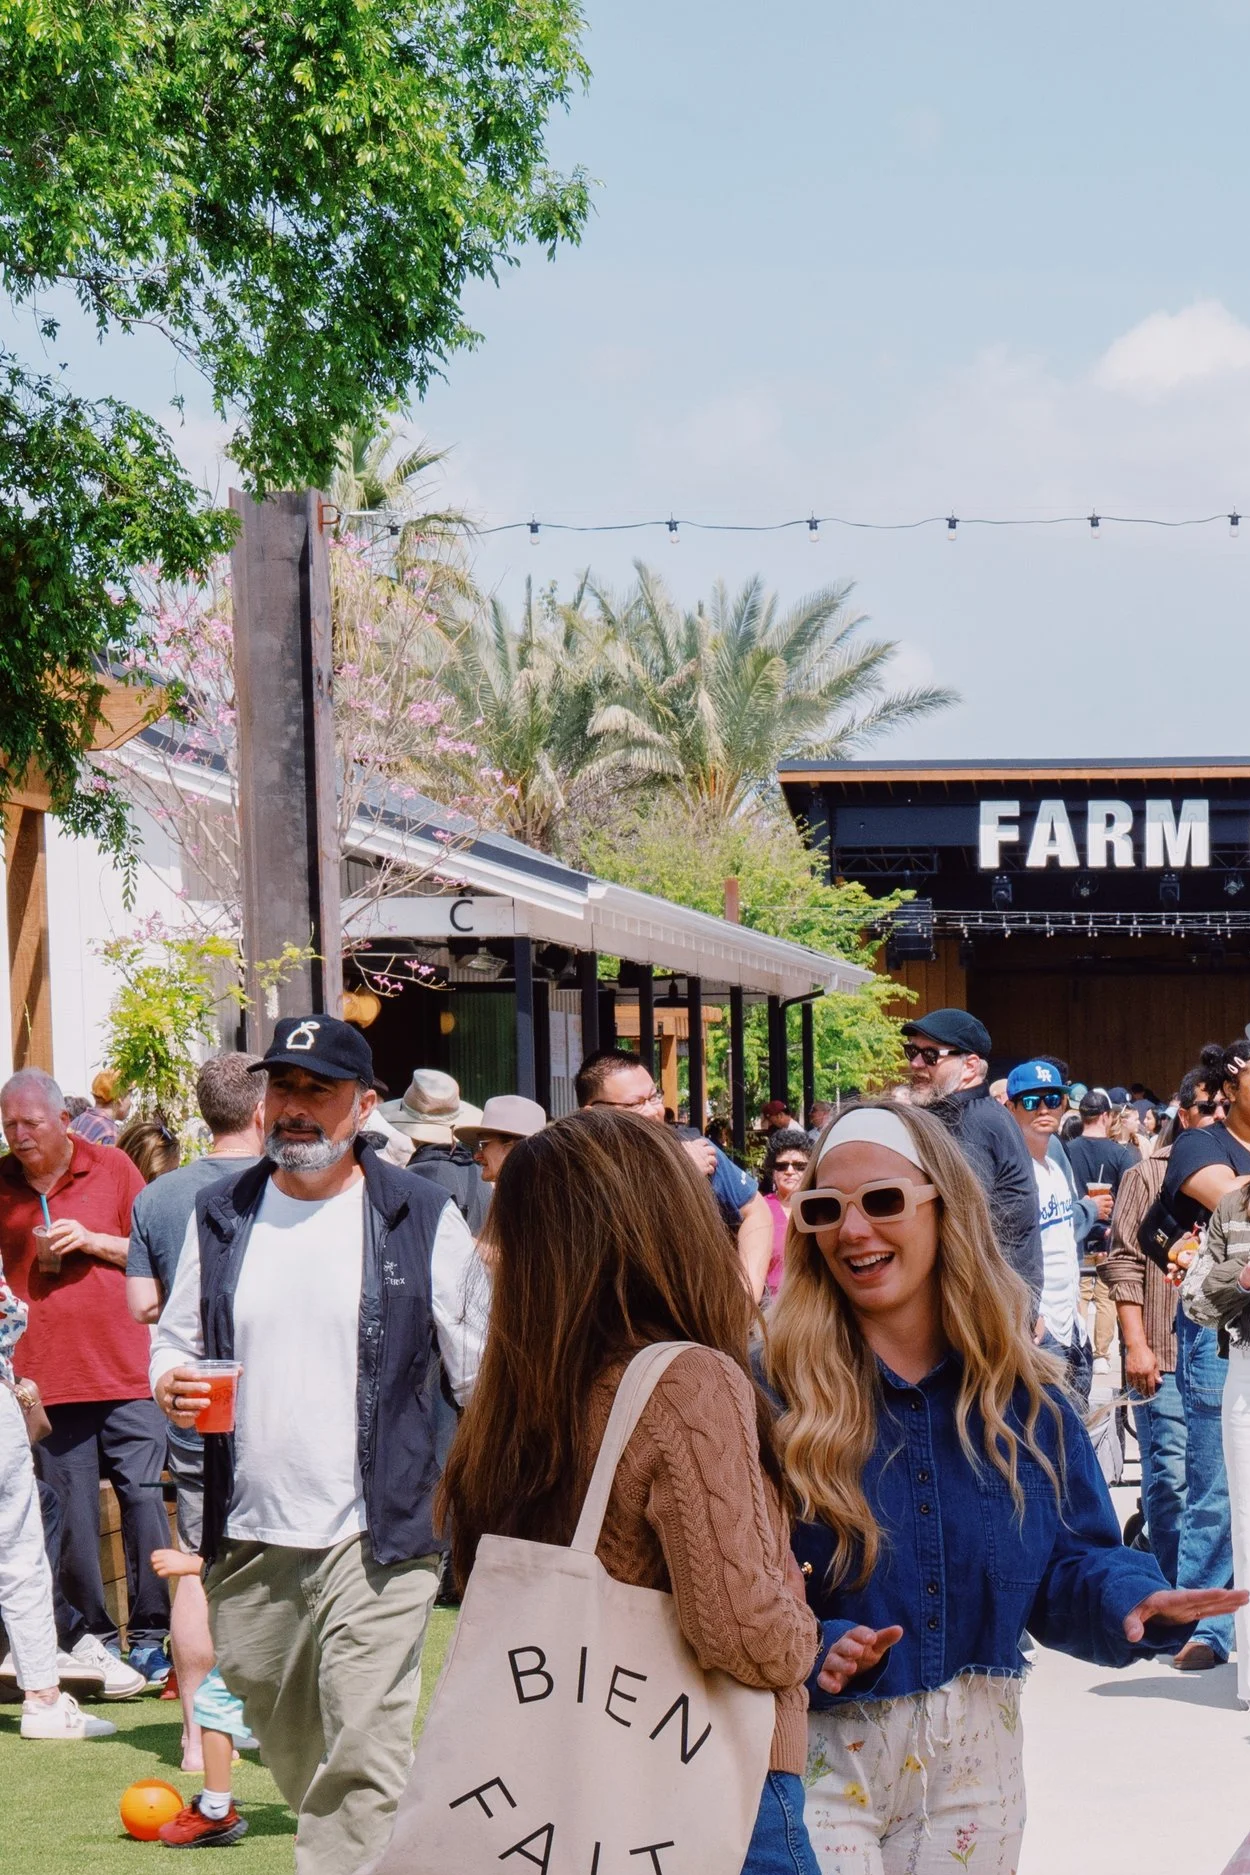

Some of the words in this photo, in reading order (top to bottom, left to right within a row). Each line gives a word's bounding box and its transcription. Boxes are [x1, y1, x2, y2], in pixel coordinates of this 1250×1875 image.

[978, 799, 1210, 869] FARM
[449, 898, 474, 933] C
[507, 1645, 712, 1765] BIEN
